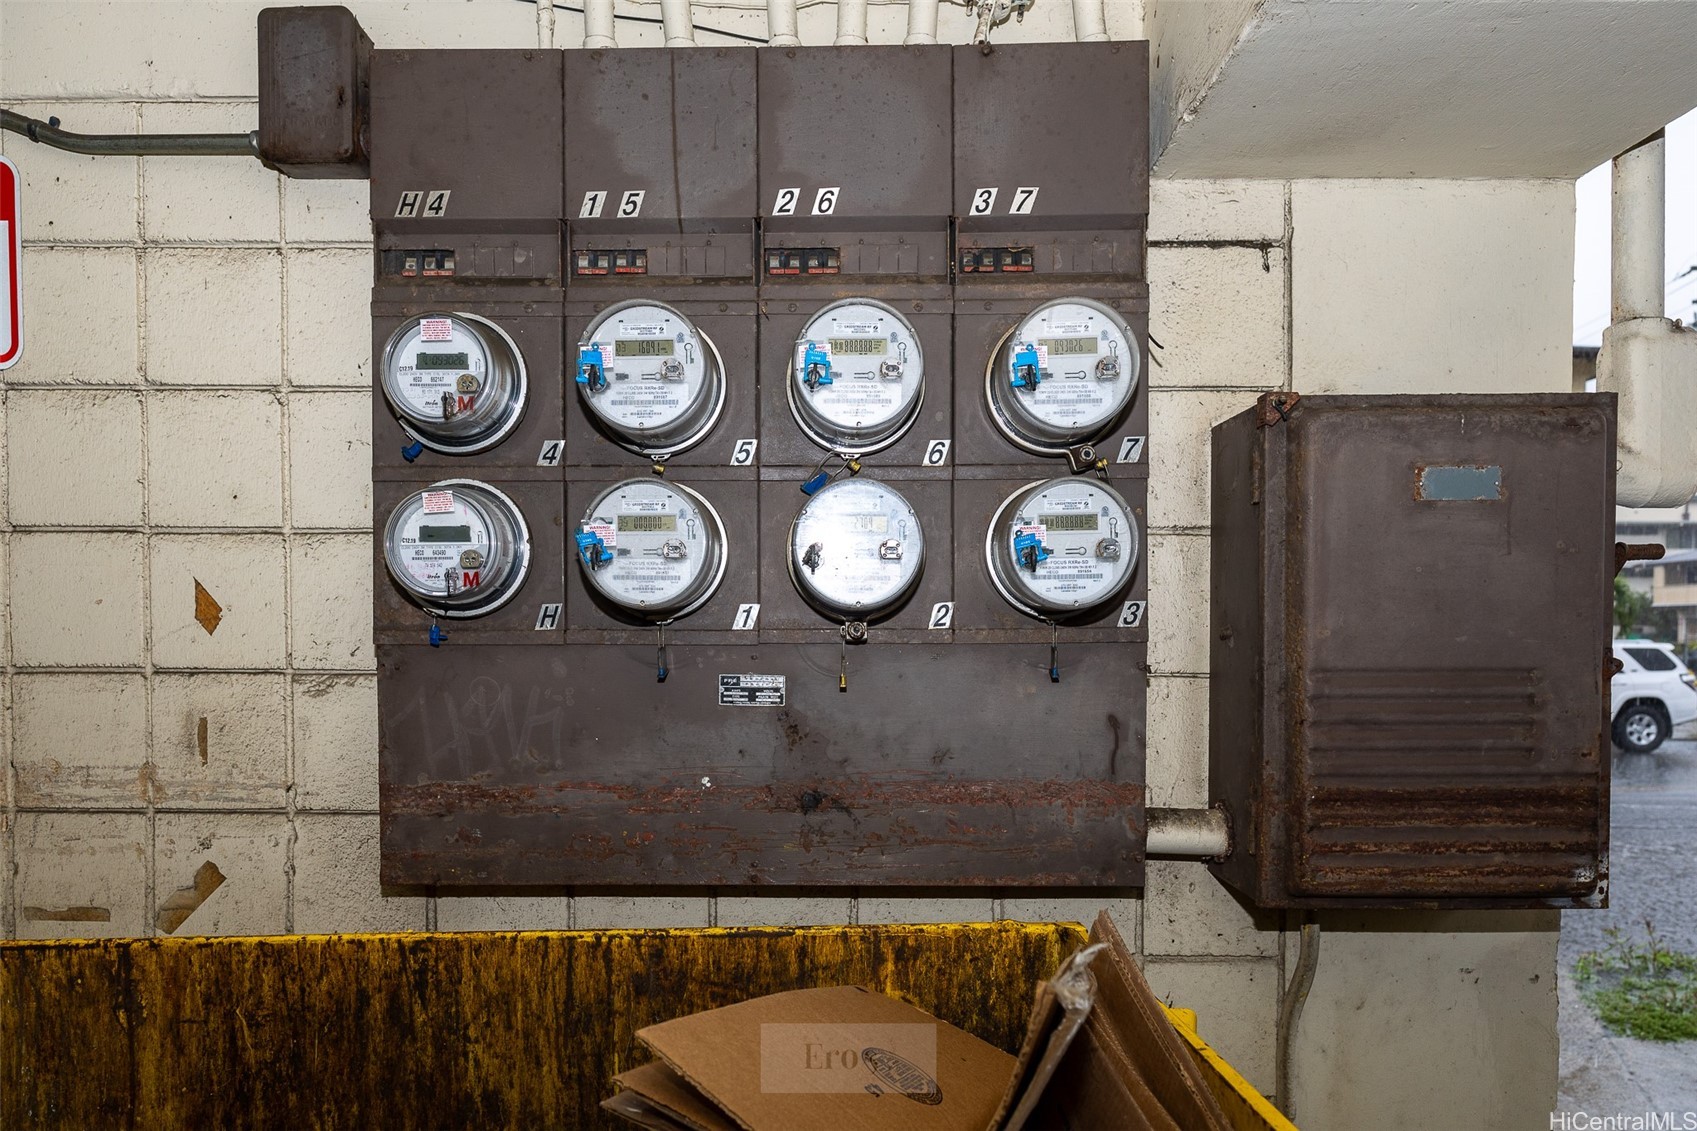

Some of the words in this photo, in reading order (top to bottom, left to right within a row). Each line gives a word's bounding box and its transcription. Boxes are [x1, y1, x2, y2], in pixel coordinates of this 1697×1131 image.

[398, 192, 420, 215] H
[428, 192, 445, 215] 4
[588, 194, 598, 216] 1
[622, 192, 640, 216] 5
[776, 190, 794, 213] 2
[818, 190, 835, 213] 6
[975, 190, 992, 213] 3
[1016, 190, 1034, 212] 7
[638, 342, 660, 353] 16091
[1055, 340, 1083, 352] 093026
[458, 396, 475, 411] M
[542, 442, 559, 464] 4
[735, 441, 754, 464] 5
[928, 441, 946, 464] 6
[1122, 438, 1140, 460] 7
[463, 571, 480, 588] M
[540, 605, 560, 628] H
[742, 605, 753, 628] 1
[933, 604, 950, 627] 2
[1123, 603, 1140, 625] 3
